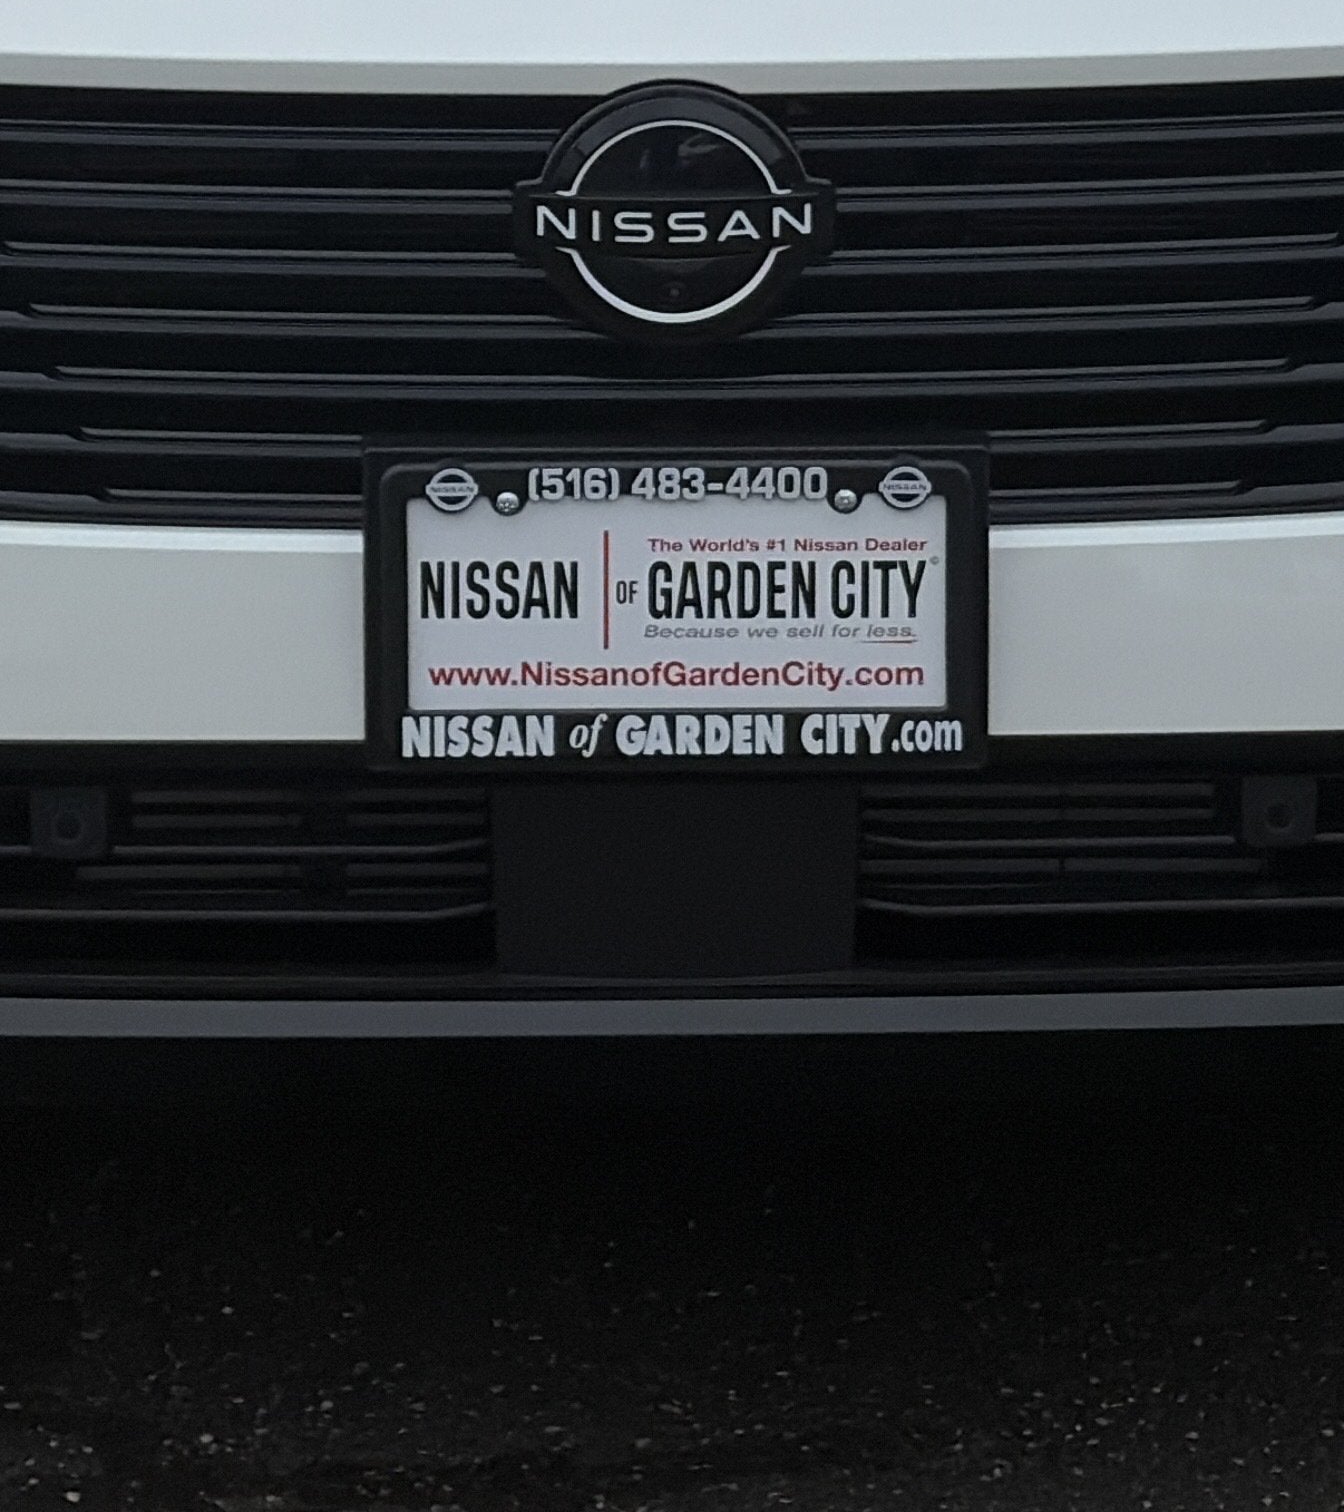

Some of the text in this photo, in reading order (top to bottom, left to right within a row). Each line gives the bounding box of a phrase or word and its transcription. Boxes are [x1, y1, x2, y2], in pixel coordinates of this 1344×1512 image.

[536, 202, 812, 243] NISSAN
[528, 467, 828, 501] (516) 483-4400
[648, 538, 928, 553] The World's #1 Nissan Dealer
[420, 559, 927, 620] NISSAN OF GARDEN CITY
[644, 624, 740, 639] Because
[747, 627, 779, 638] we
[786, 624, 824, 638] sell
[831, 623, 861, 638] for
[428, 660, 924, 692] www.NissanofGardenCity.com
[402, 712, 963, 758] NISSAN of GARDEN CITY.com
